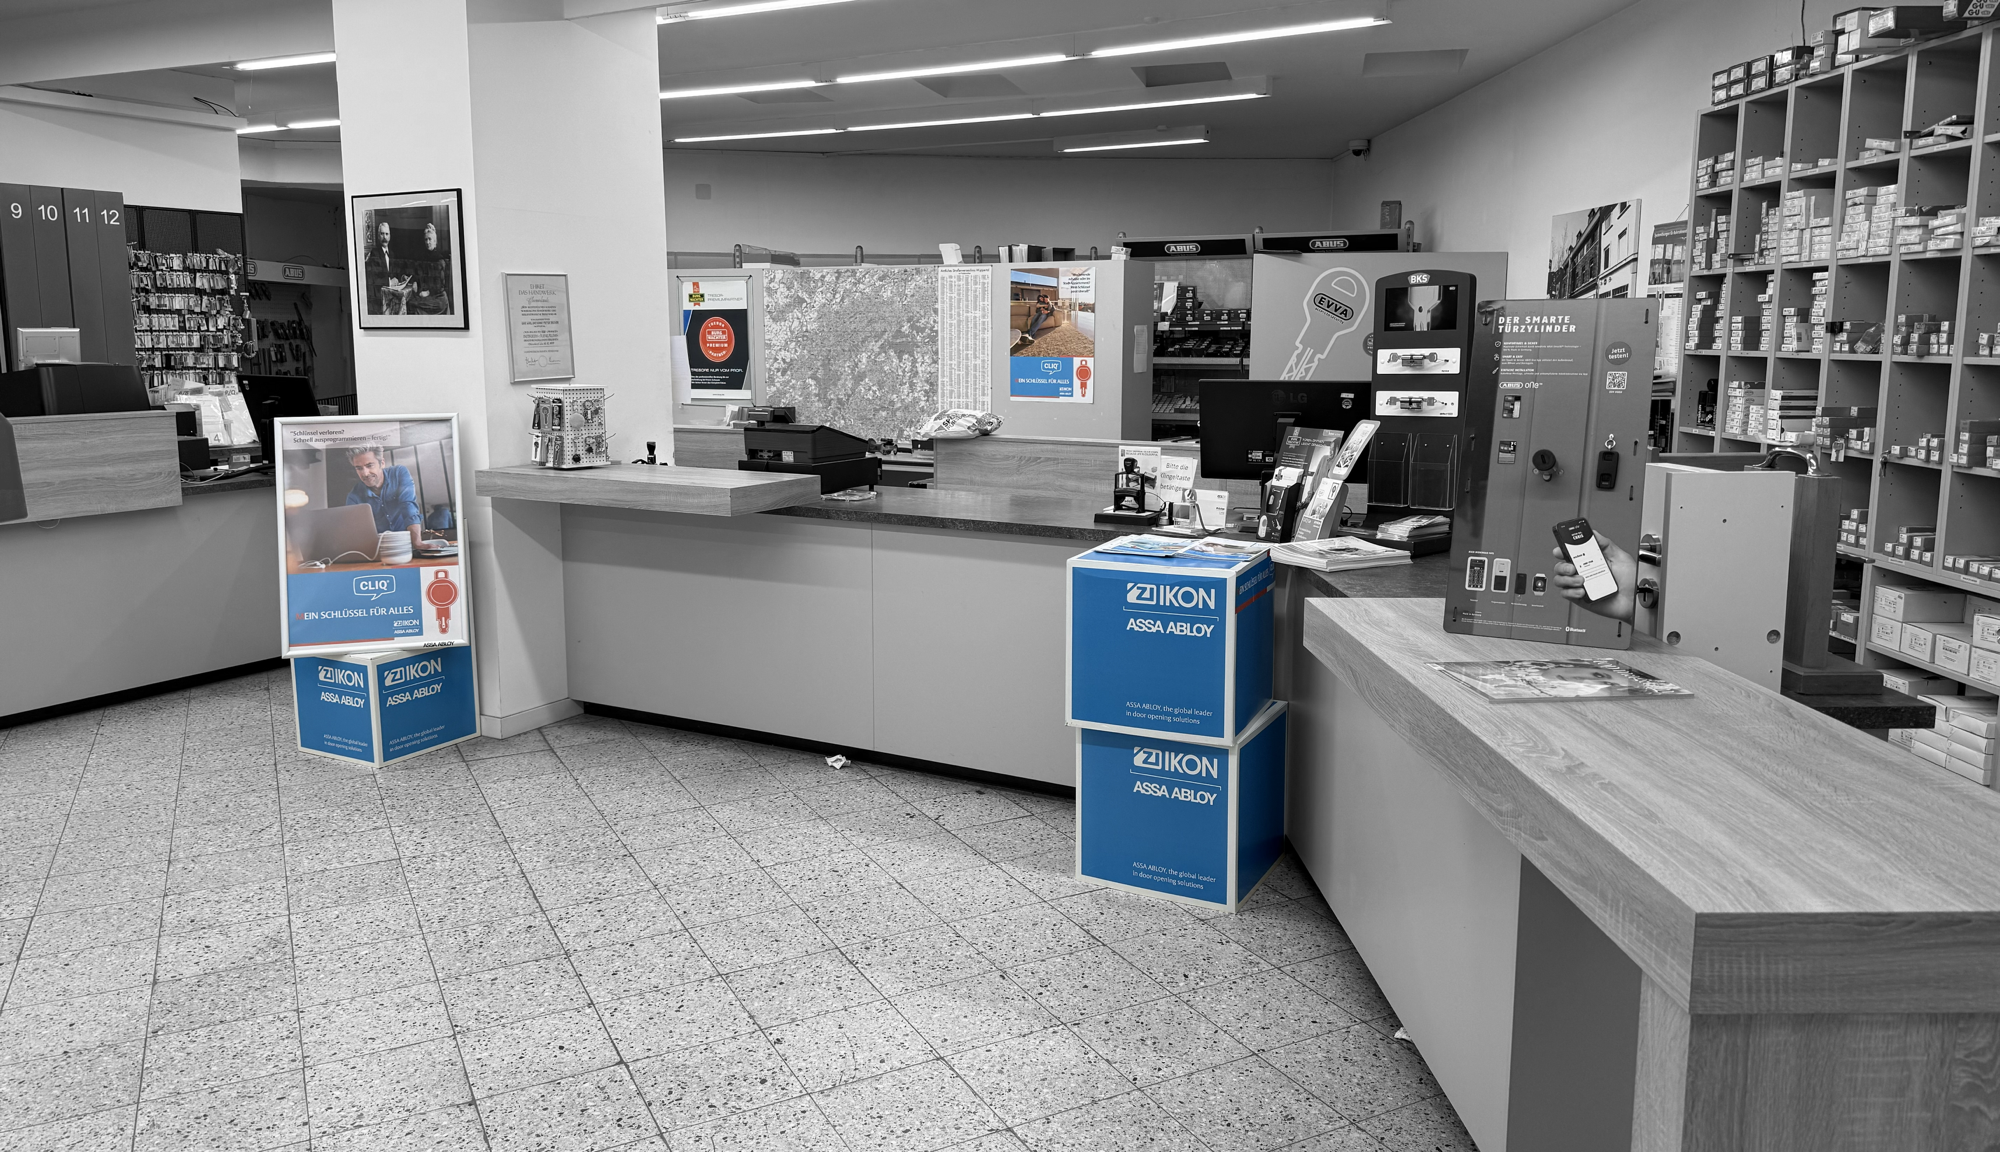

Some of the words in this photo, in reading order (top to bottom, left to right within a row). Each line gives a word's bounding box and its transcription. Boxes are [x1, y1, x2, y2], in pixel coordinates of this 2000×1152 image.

[11, 203, 22, 218] 9
[38, 205, 58, 220] 10
[73, 207, 89, 222] 11
[100, 209, 120, 225] 12
[1169, 244, 1197, 252] ABUS
[1313, 240, 1345, 248] ABUS
[1410, 274, 1428, 283] BKS
[1318, 296, 1349, 318] EVVA
[1498, 316, 1520, 324] DER
[1525, 315, 1571, 324] SMARTE
[1498, 323, 1576, 333] TÜRZYLINDER
[314, 434, 367, 443] ausprogrammieren
[1165, 462, 1179, 470] Bitte
[1160, 483, 1182, 492] betätige
[360, 580, 389, 591] CLIQ
[1159, 584, 1216, 610] IKON
[296, 612, 319, 620] MEIN
[320, 608, 368, 620] SCHLÜSSEL
[370, 606, 388, 617] FÜR
[389, 605, 414, 615] ALLES
[1126, 617, 1165, 634] ASSA
[1166, 620, 1215, 638] ABLOY
[405, 657, 442, 681] IKON
[334, 668, 364, 689] IKON
[320, 691, 340, 704] ASSA
[341, 695, 365, 708] ABLOY
[386, 691, 412, 708] ASSA
[412, 682, 443, 700] ABLOY
[1126, 701, 1141, 709] ASSA
[1163, 705, 1174, 713] the
[1174, 706, 1193, 715] global
[1193, 708, 1213, 717] leader
[1132, 710, 1146, 719] door
[1147, 713, 1172, 723] opening
[1172, 716, 1200, 725] solutions
[1164, 750, 1218, 779] IKON
[1133, 780, 1169, 799] ASSA
[1170, 787, 1218, 806] ABLOY
[1132, 861, 1147, 870] ASSA
[1147, 864, 1168, 875] ABLOY,
[1168, 868, 1178, 876] the
[1178, 870, 1197, 880] global
[1197, 873, 1216, 883] leader
[1138, 870, 1153, 880] door
[1153, 874, 1177, 886] opening
[1177, 879, 1204, 890] solutions
